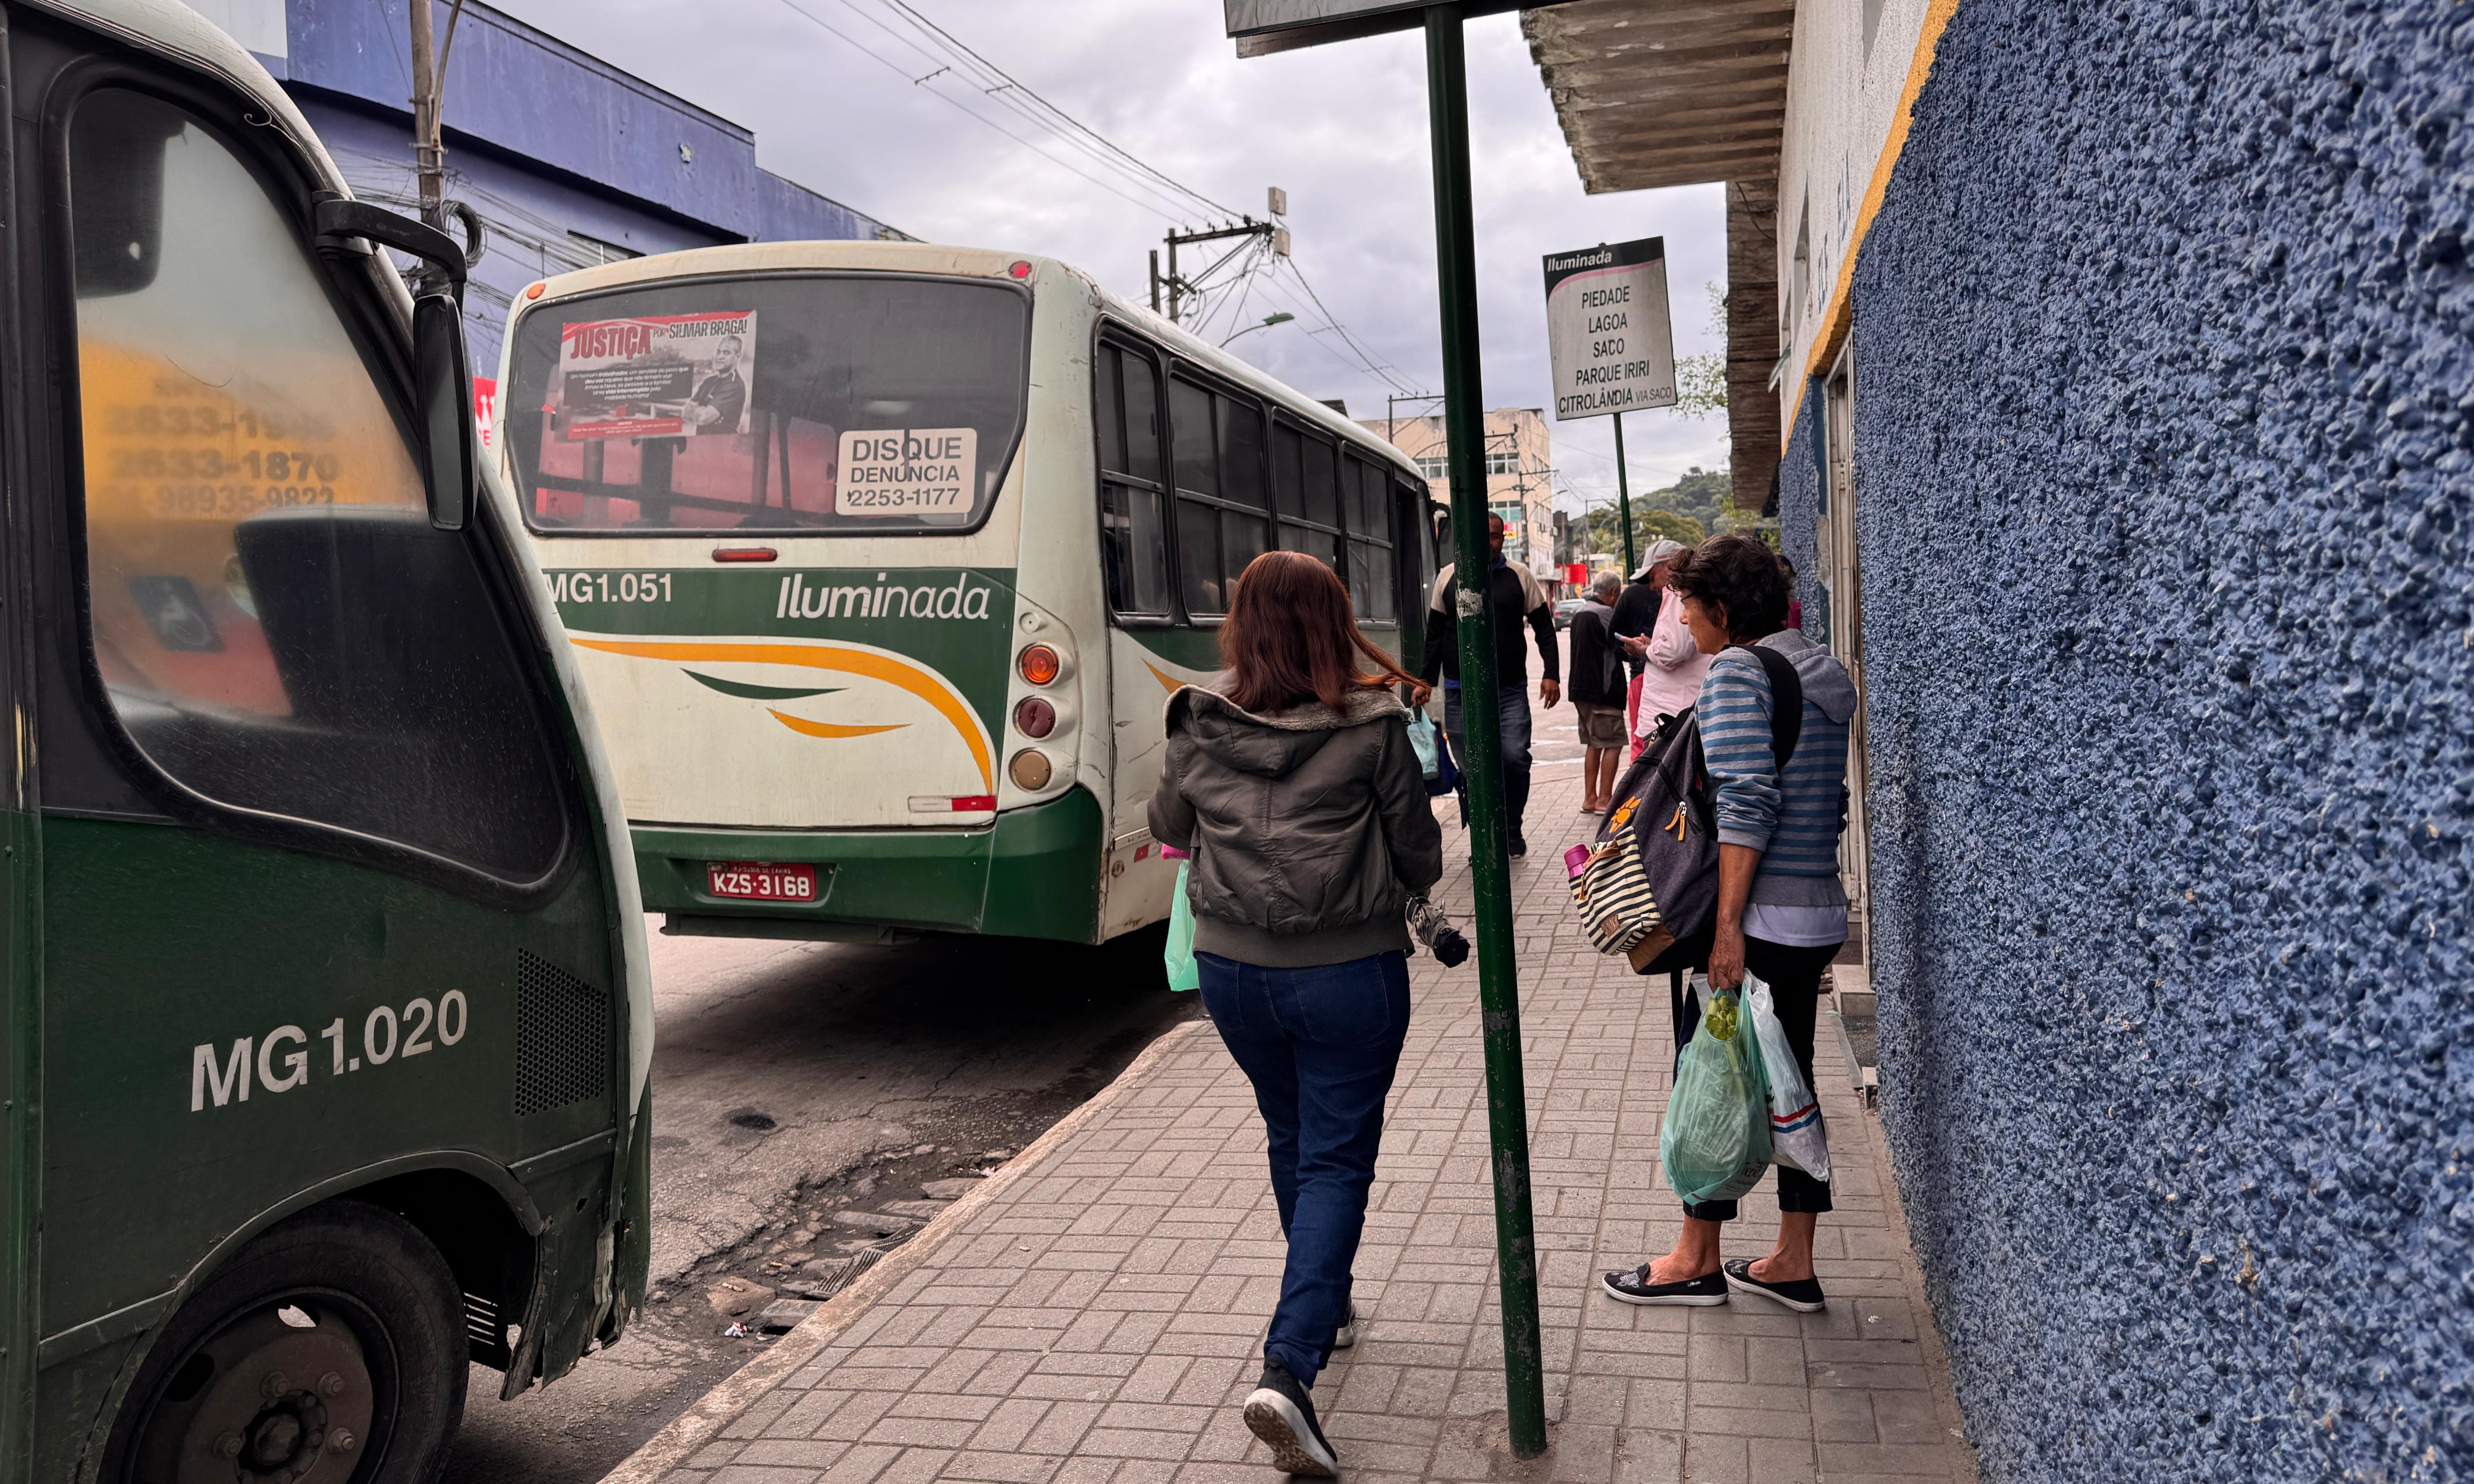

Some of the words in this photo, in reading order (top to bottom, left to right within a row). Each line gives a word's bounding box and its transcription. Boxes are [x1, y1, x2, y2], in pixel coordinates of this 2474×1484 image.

[1547, 250, 1612, 272] Iluminada
[1581, 286, 1630, 309] PIEDADE
[1588, 313, 1628, 333] LAGOA
[570, 326, 651, 360] JUSTIÇA
[669, 321, 708, 339] SILMAR
[709, 319, 748, 336] BRAGA!
[1593, 338, 1625, 358] SACO
[1576, 364, 1621, 386] PARQUE
[1625, 360, 1650, 379] IRIRI
[1559, 388, 1633, 413] CITROLÂNDIA
[1635, 390, 1648, 403] VIA
[1649, 386, 1672, 401] SACO
[852, 436, 962, 462] DISQUE
[850, 463, 960, 483] DENÚNCIA
[850, 488, 960, 507] 2253-1177
[543, 572, 671, 603] MG1.051
[776, 572, 990, 620] Iluminada
